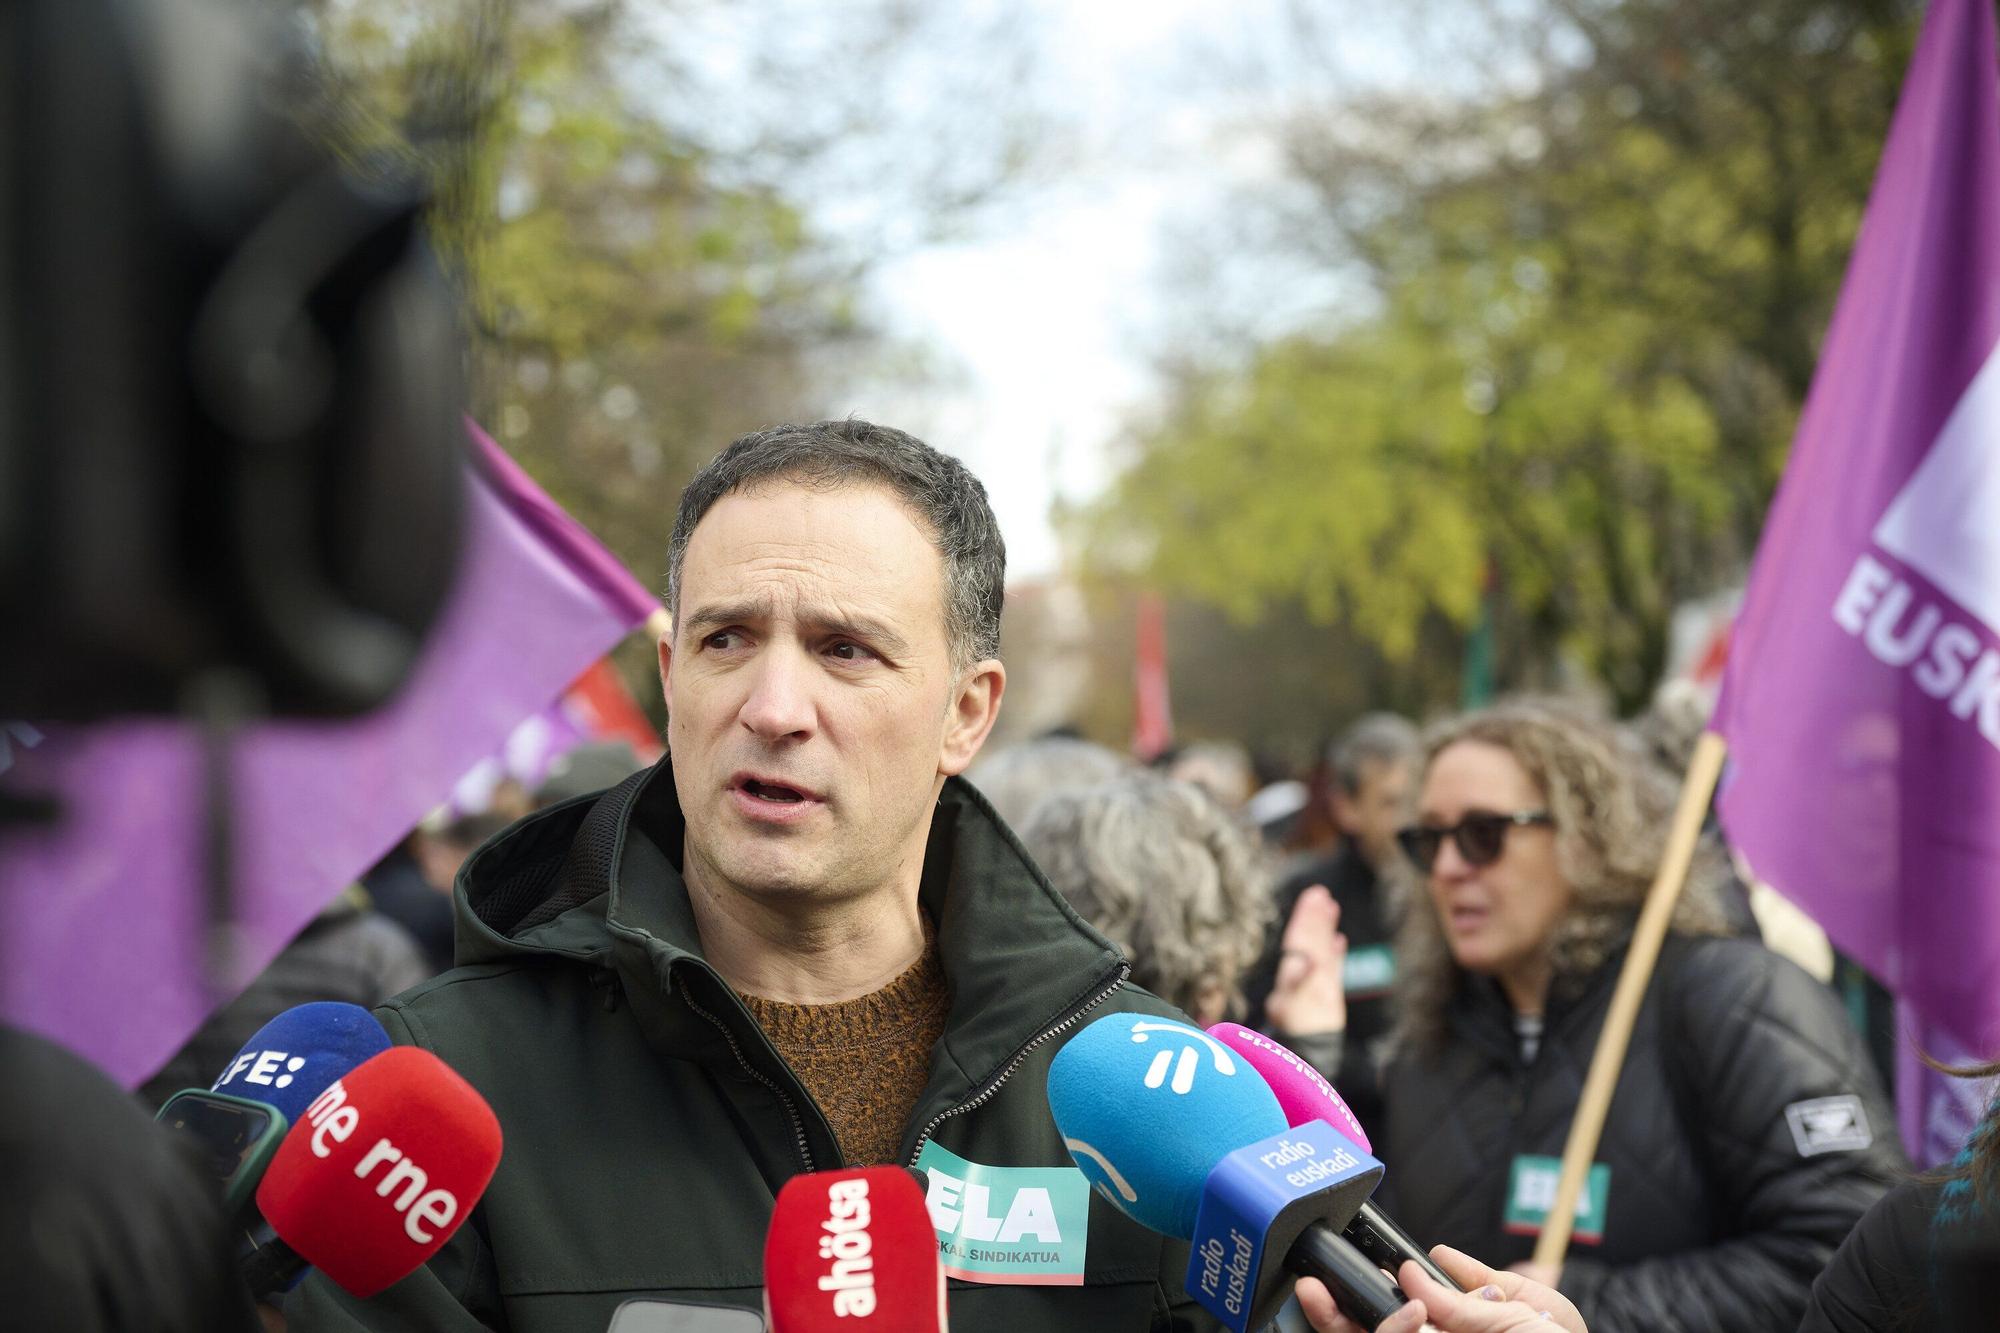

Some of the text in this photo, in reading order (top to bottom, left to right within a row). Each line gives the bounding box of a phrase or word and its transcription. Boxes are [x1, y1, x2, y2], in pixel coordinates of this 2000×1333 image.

[1259, 1137, 1316, 1170] radio
[1285, 1147, 1360, 1188] euskadi
[354, 1137, 458, 1245] rne
[925, 1166, 1062, 1243] ELA
[818, 1177, 877, 1318] ahötsa
[969, 1248, 1061, 1264] SINDIKATUA
[1200, 1238, 1225, 1298] radio
[1224, 1228, 1254, 1316] euskadi
